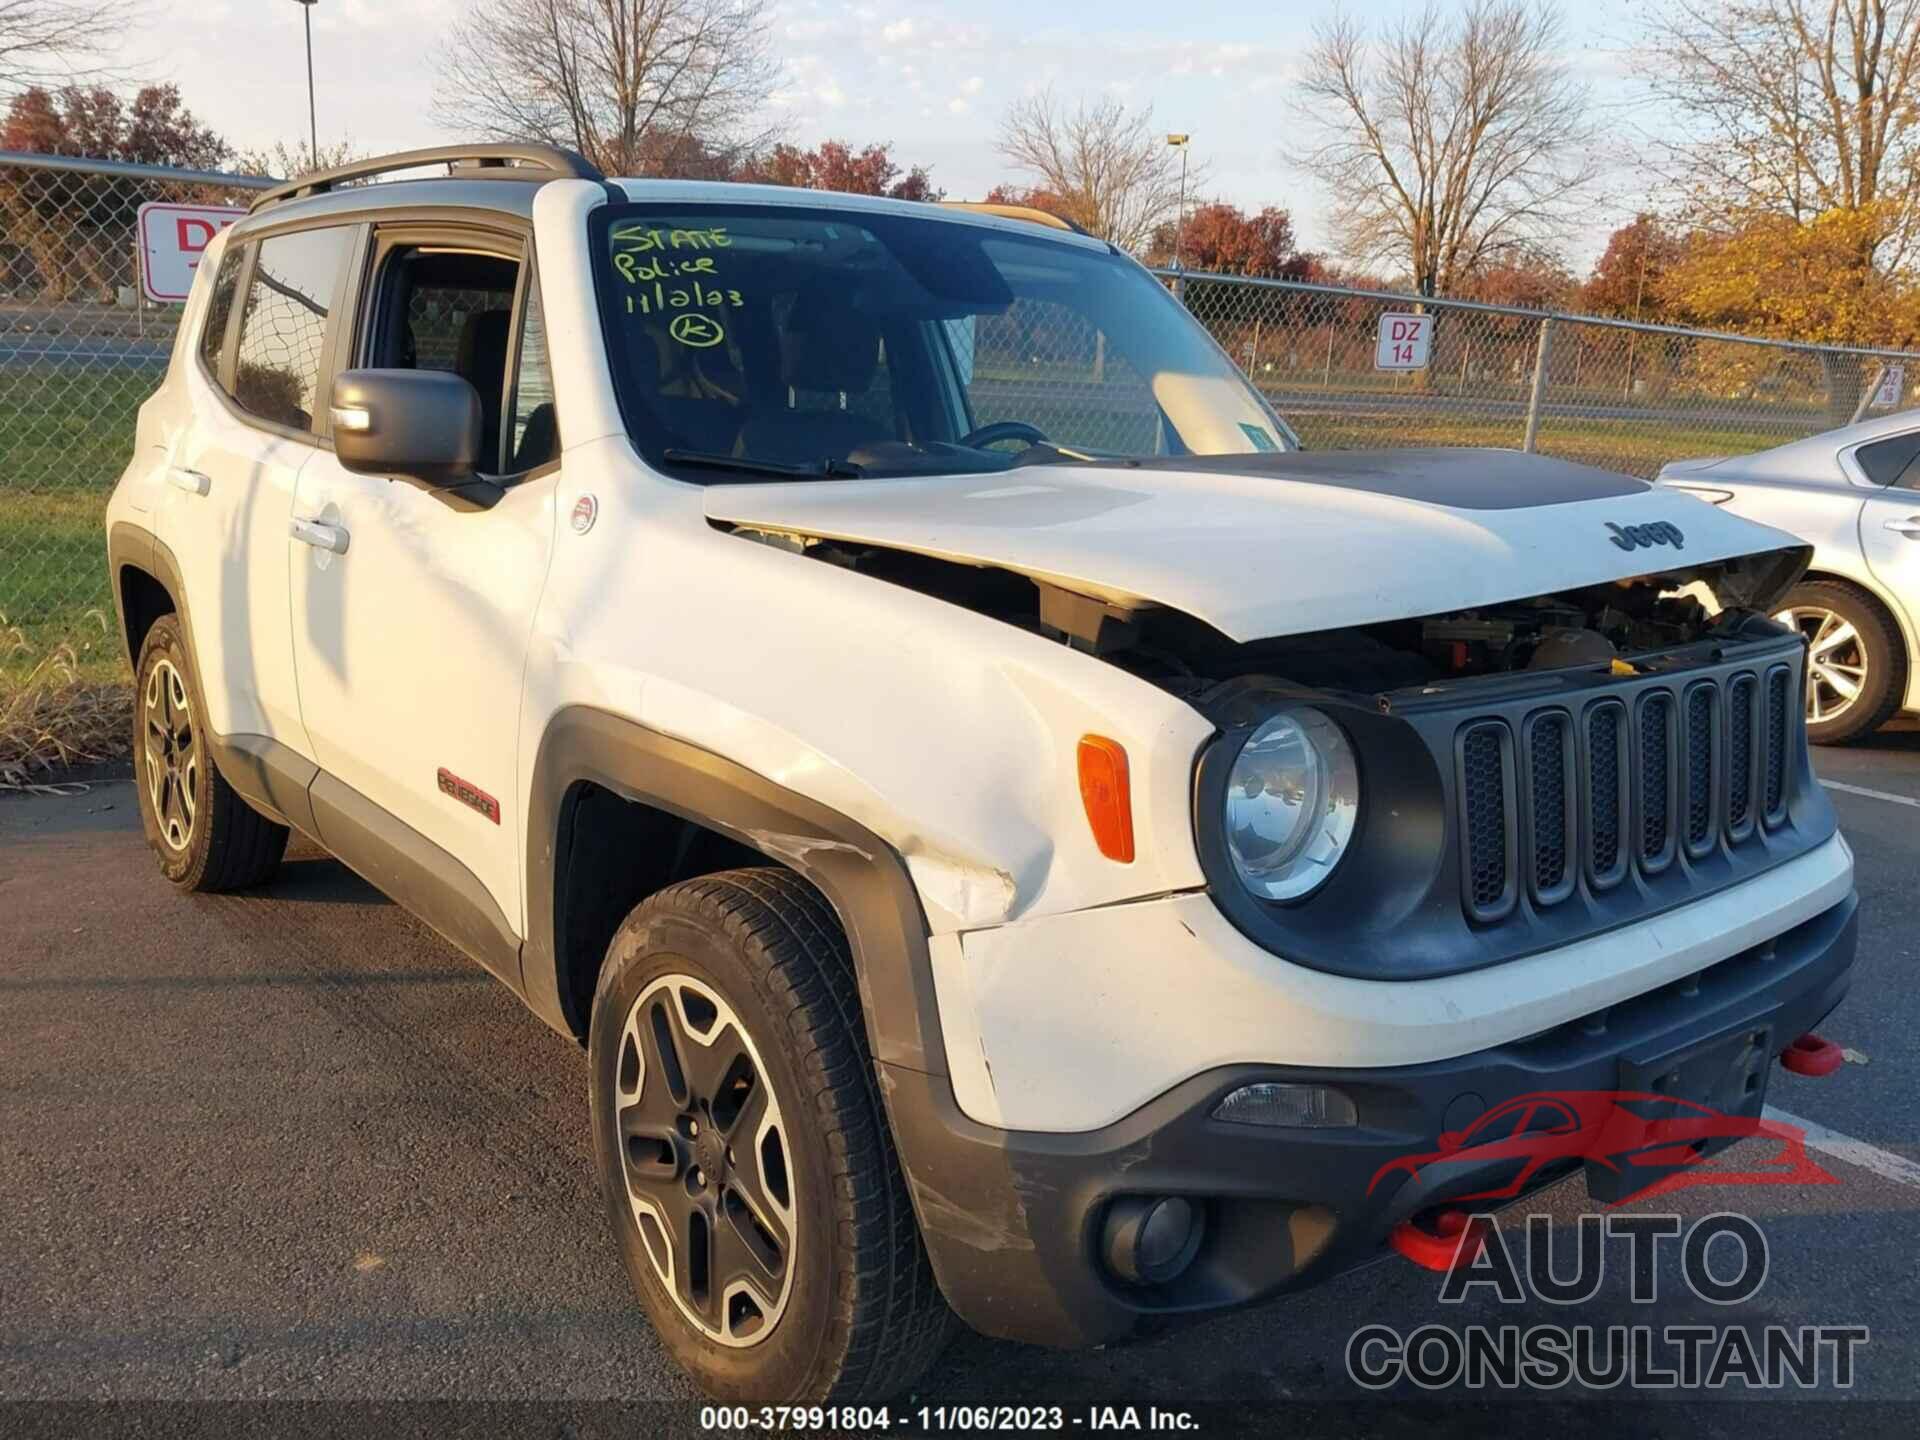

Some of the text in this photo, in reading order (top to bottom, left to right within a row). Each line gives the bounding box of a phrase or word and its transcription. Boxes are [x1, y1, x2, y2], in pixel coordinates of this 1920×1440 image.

[176, 218, 235, 252] D
[612, 225, 732, 253] STATE
[614, 253, 719, 284] Police
[626, 281, 744, 314] 11/2/23
[1391, 321, 1421, 341] DZ
[1392, 344, 1412, 363] 14
[1603, 520, 1685, 552] Jeep
